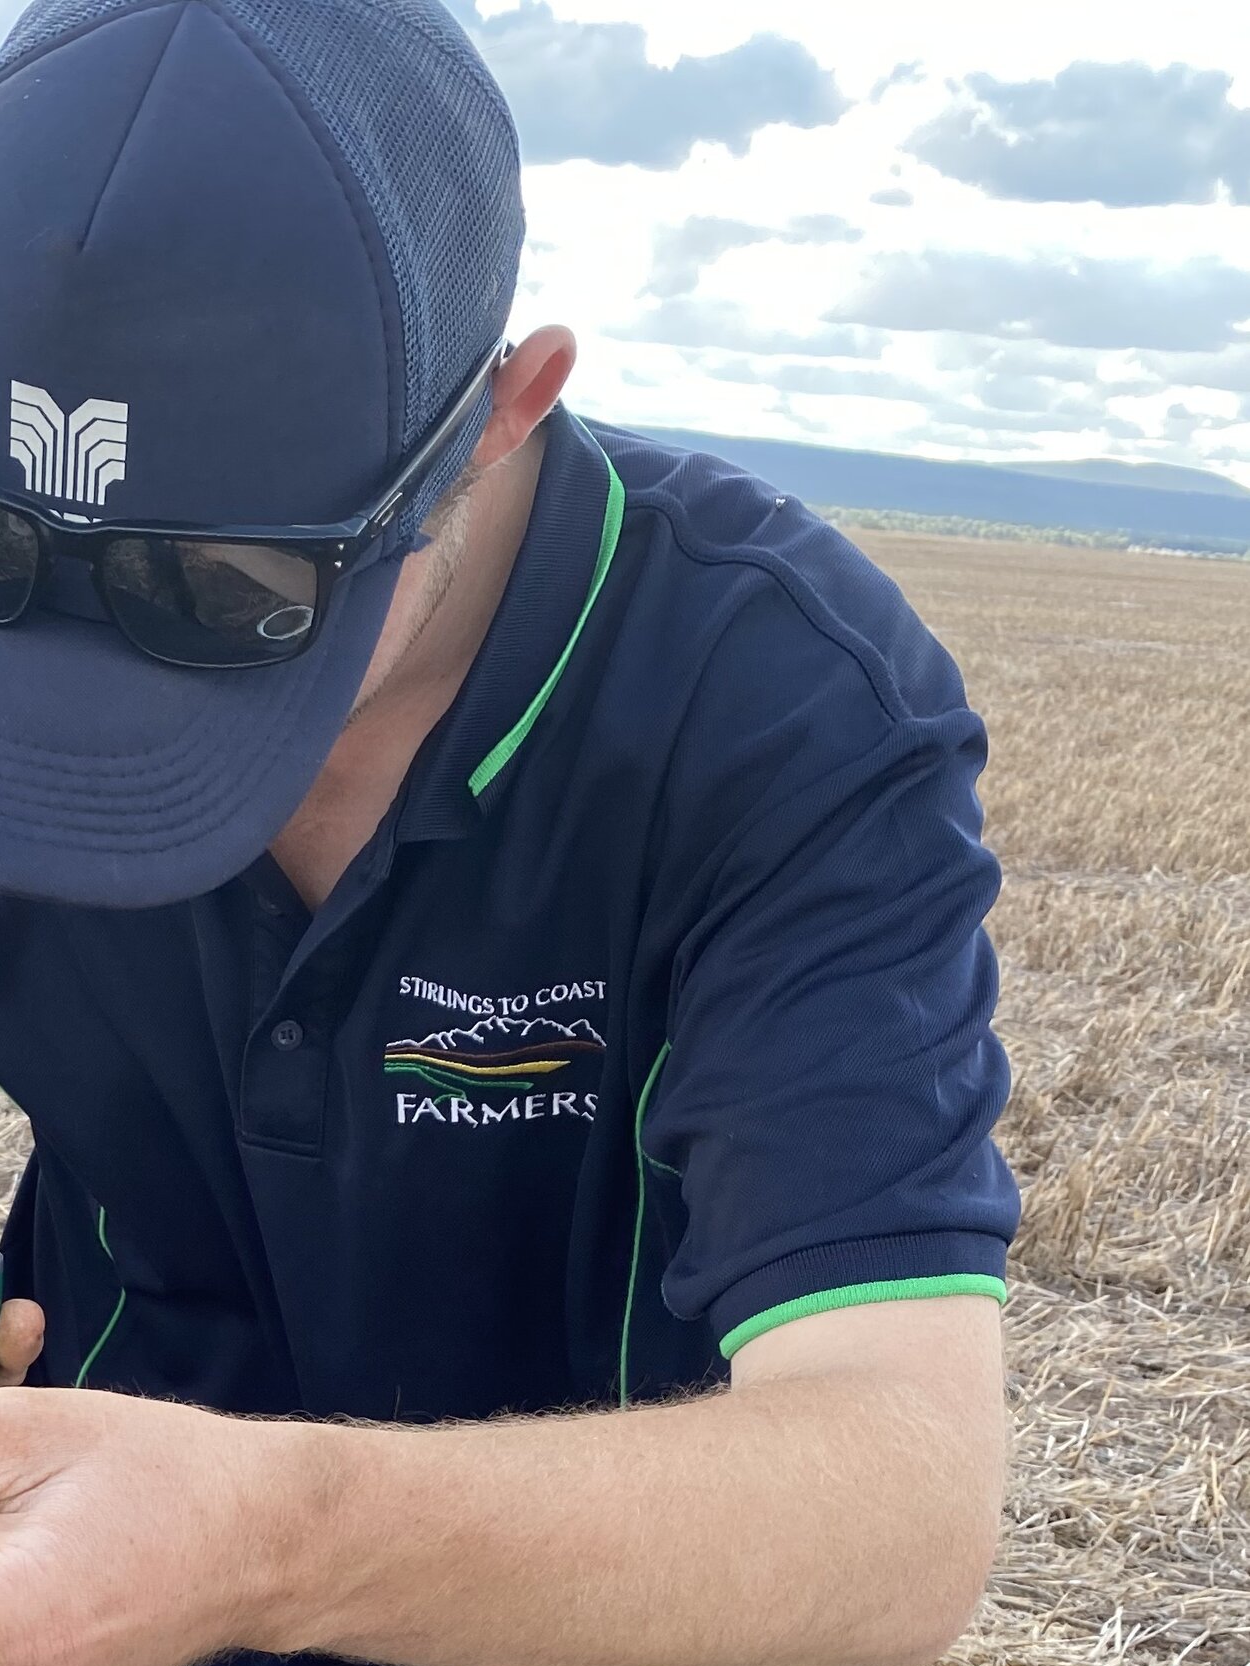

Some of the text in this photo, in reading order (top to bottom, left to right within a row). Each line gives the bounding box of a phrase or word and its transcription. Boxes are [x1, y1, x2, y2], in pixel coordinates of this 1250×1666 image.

[399, 976, 607, 1016] STIRLINGS TO COAST
[396, 1092, 599, 1128] FARMERS
